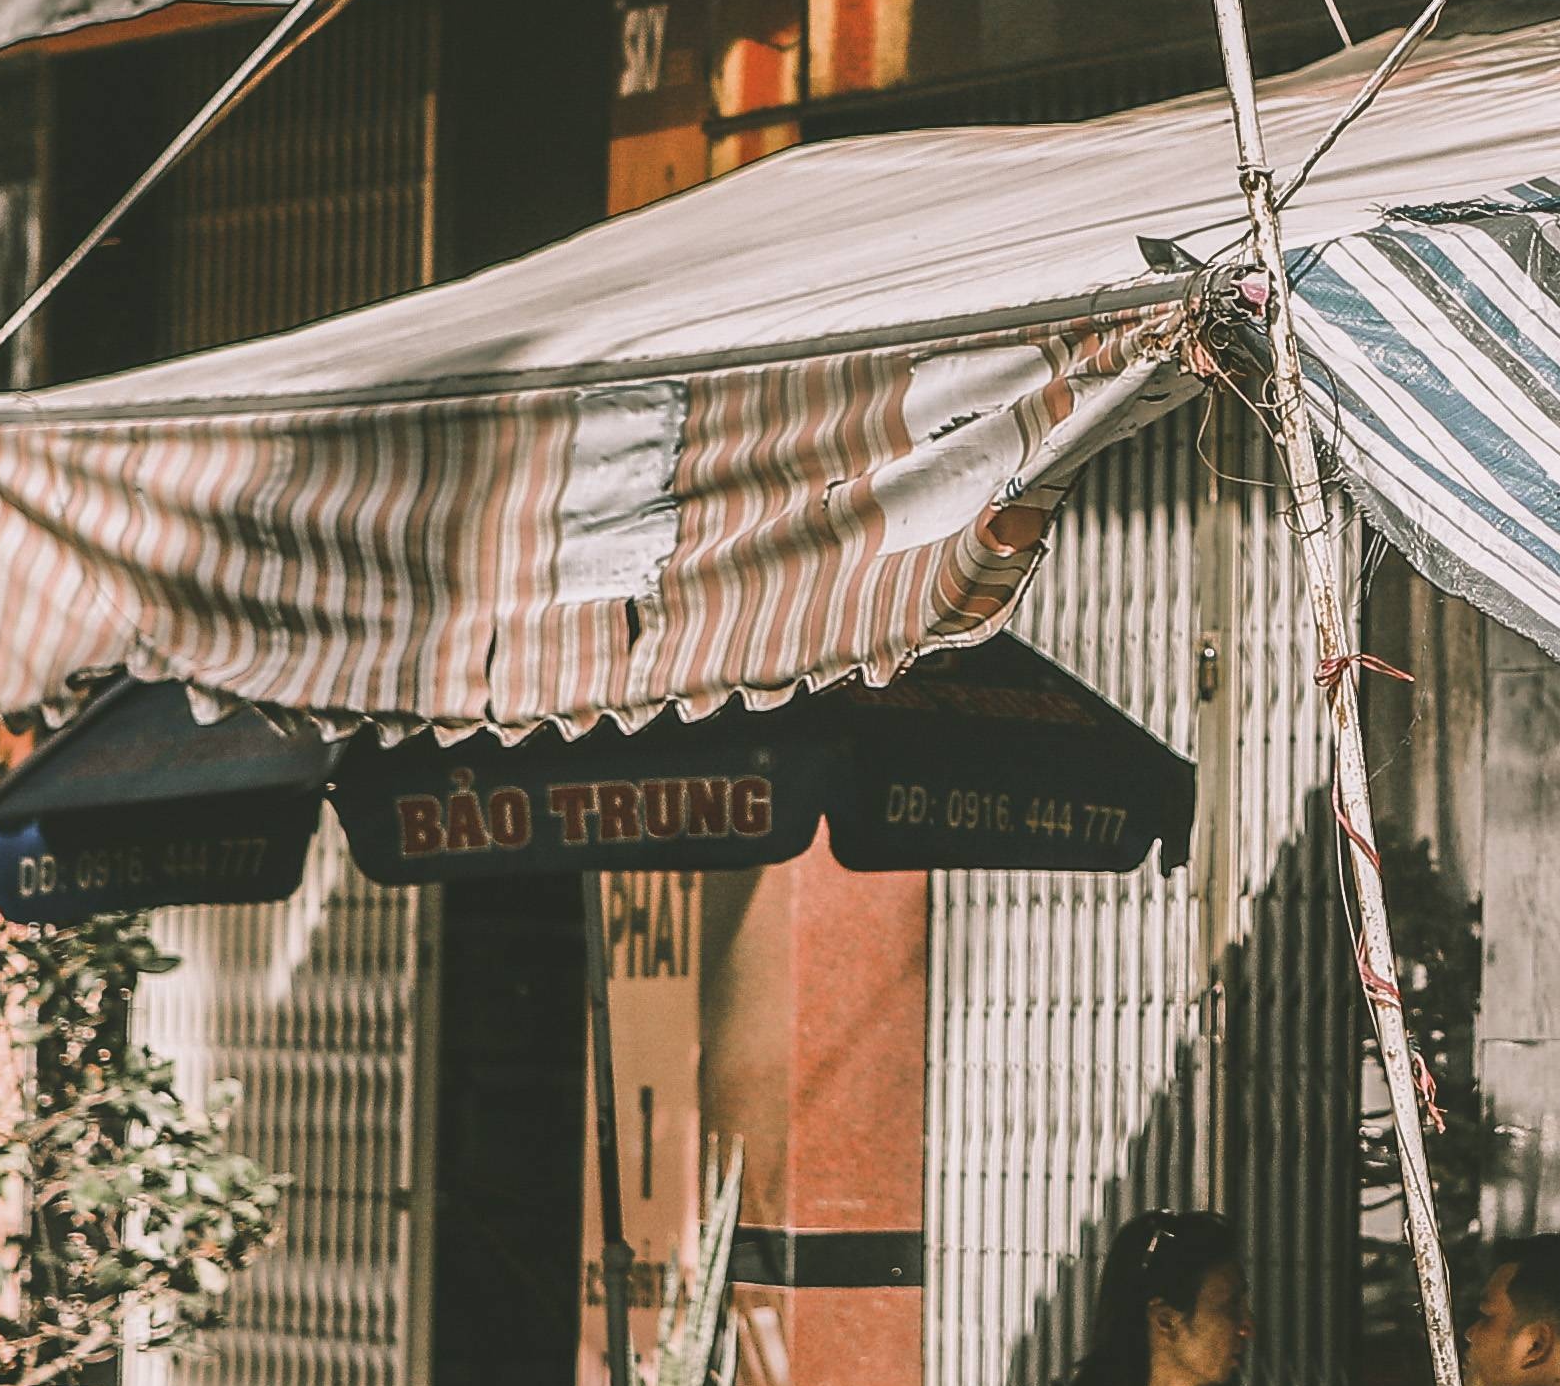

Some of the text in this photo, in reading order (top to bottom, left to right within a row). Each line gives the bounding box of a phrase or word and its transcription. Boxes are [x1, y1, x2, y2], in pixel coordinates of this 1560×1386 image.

[395, 766, 773, 860] BẢO TRUNG
[1026, 798, 1073, 838] 444
[1083, 804, 1127, 844] 777
